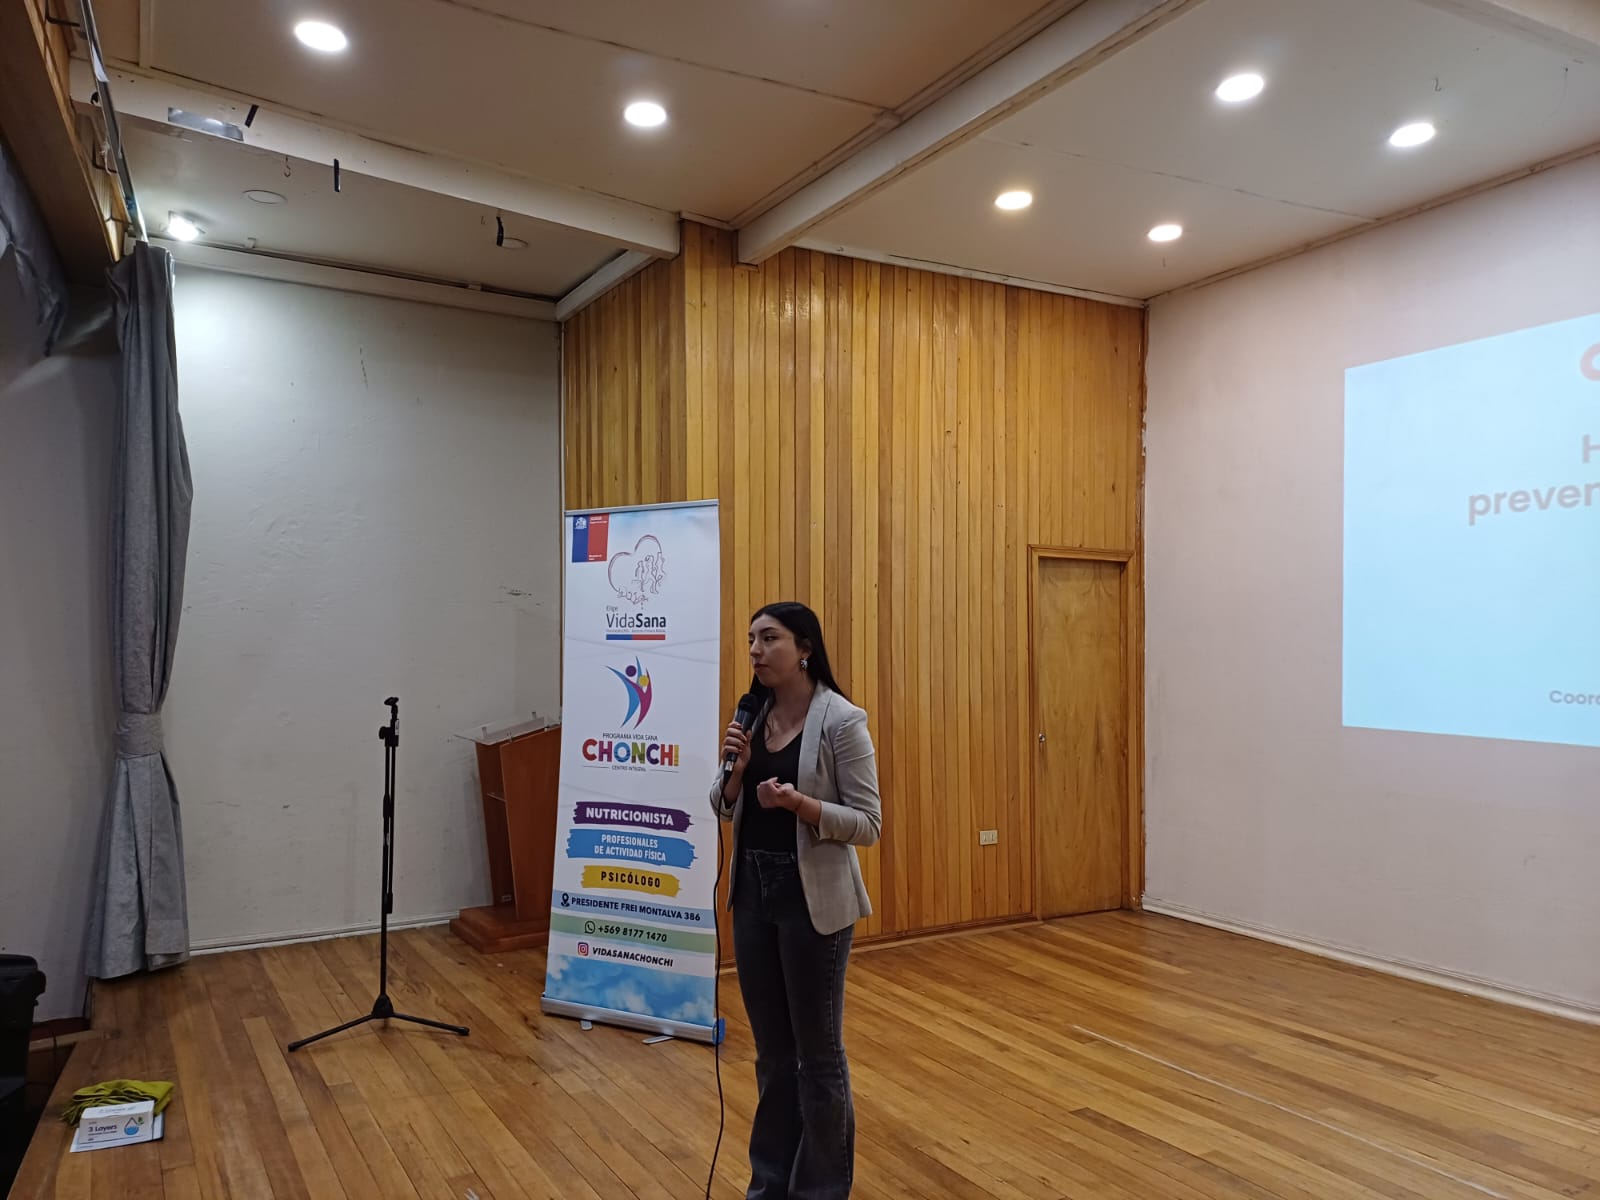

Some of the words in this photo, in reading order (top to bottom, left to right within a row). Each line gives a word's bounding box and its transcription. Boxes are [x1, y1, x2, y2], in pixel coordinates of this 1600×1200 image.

[606, 612, 666, 628] VidaSana
[602, 732, 632, 740] PROGRAMA
[582, 738, 680, 767] CHONCHI
[586, 807, 674, 826] NUTRICIONISTA
[601, 834, 658, 848] PROFESIONALES
[594, 845, 604, 855] DE
[606, 846, 643, 858] ACTIVIDAD
[644, 848, 666, 861] FÍSICA
[601, 871, 660, 888] PSICÓLOGO
[571, 897, 619, 910] PRESIDENTE
[621, 902, 638, 912] FREI
[639, 905, 682, 919] MONTALVA
[684, 912, 701, 921] 386
[598, 925, 621, 934] +569
[622, 927, 644, 938] 8177
[646, 931, 667, 942] 1470
[592, 946, 674, 967] VIDASANACHONCHI
[95, 1124, 118, 1132] Layers
